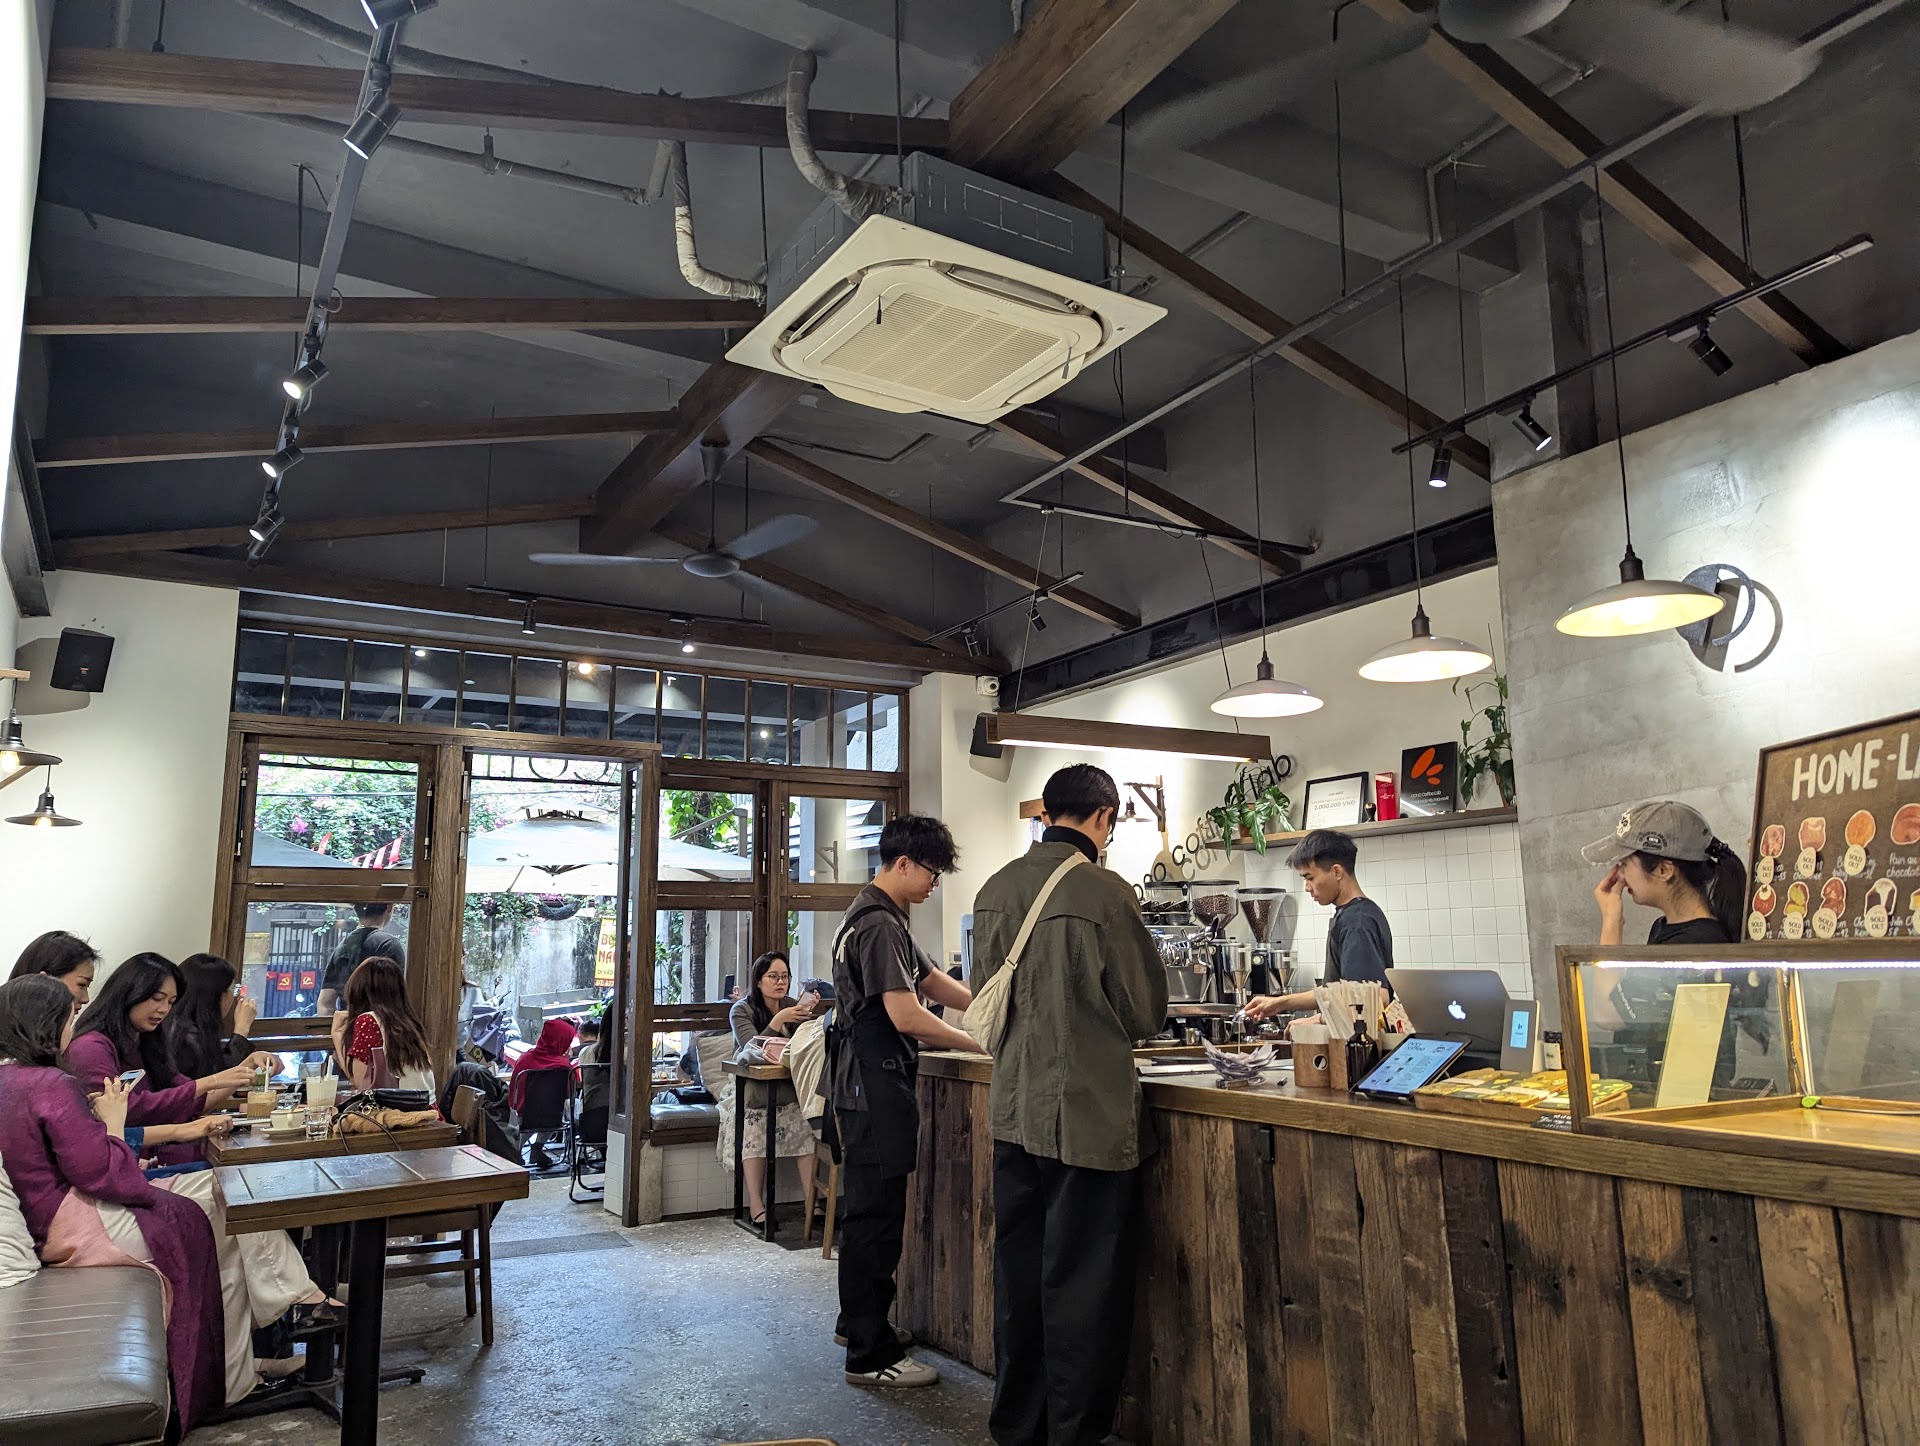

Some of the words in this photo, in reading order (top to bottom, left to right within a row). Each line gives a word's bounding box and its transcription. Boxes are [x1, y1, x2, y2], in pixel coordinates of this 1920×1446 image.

[1848, 853, 1863, 863] SOLD
[1848, 860, 1860, 869] OUT
[1788, 920, 1802, 928] SOLD
[1817, 916, 1835, 928] SOLD
[1788, 928, 1800, 936] OUT
[1818, 923, 1831, 934] OUT
